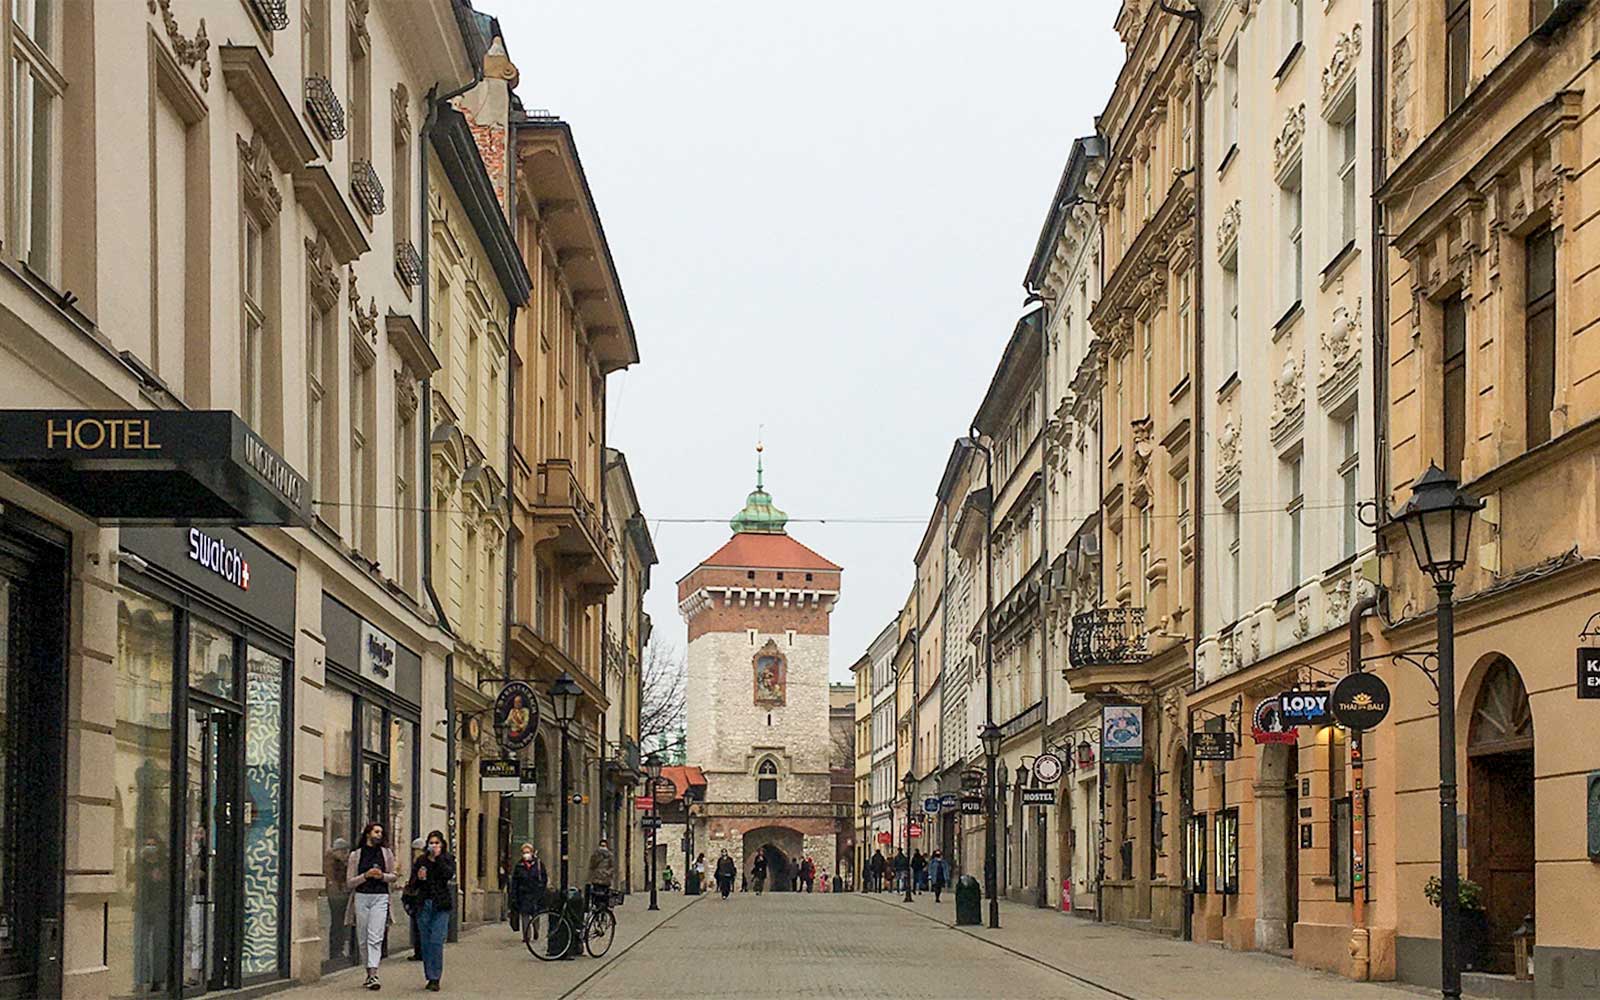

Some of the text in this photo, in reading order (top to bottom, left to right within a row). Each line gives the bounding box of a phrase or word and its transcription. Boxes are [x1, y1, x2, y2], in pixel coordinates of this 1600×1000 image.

[47, 418, 161, 450] HOTEL
[189, 527, 242, 586] swatch
[1586, 659, 1600, 671] K
[1282, 696, 1328, 711] LODY
[1367, 703, 1384, 711] BALI
[1023, 793, 1054, 801] HOSTEL
[962, 803, 980, 811] PUB
